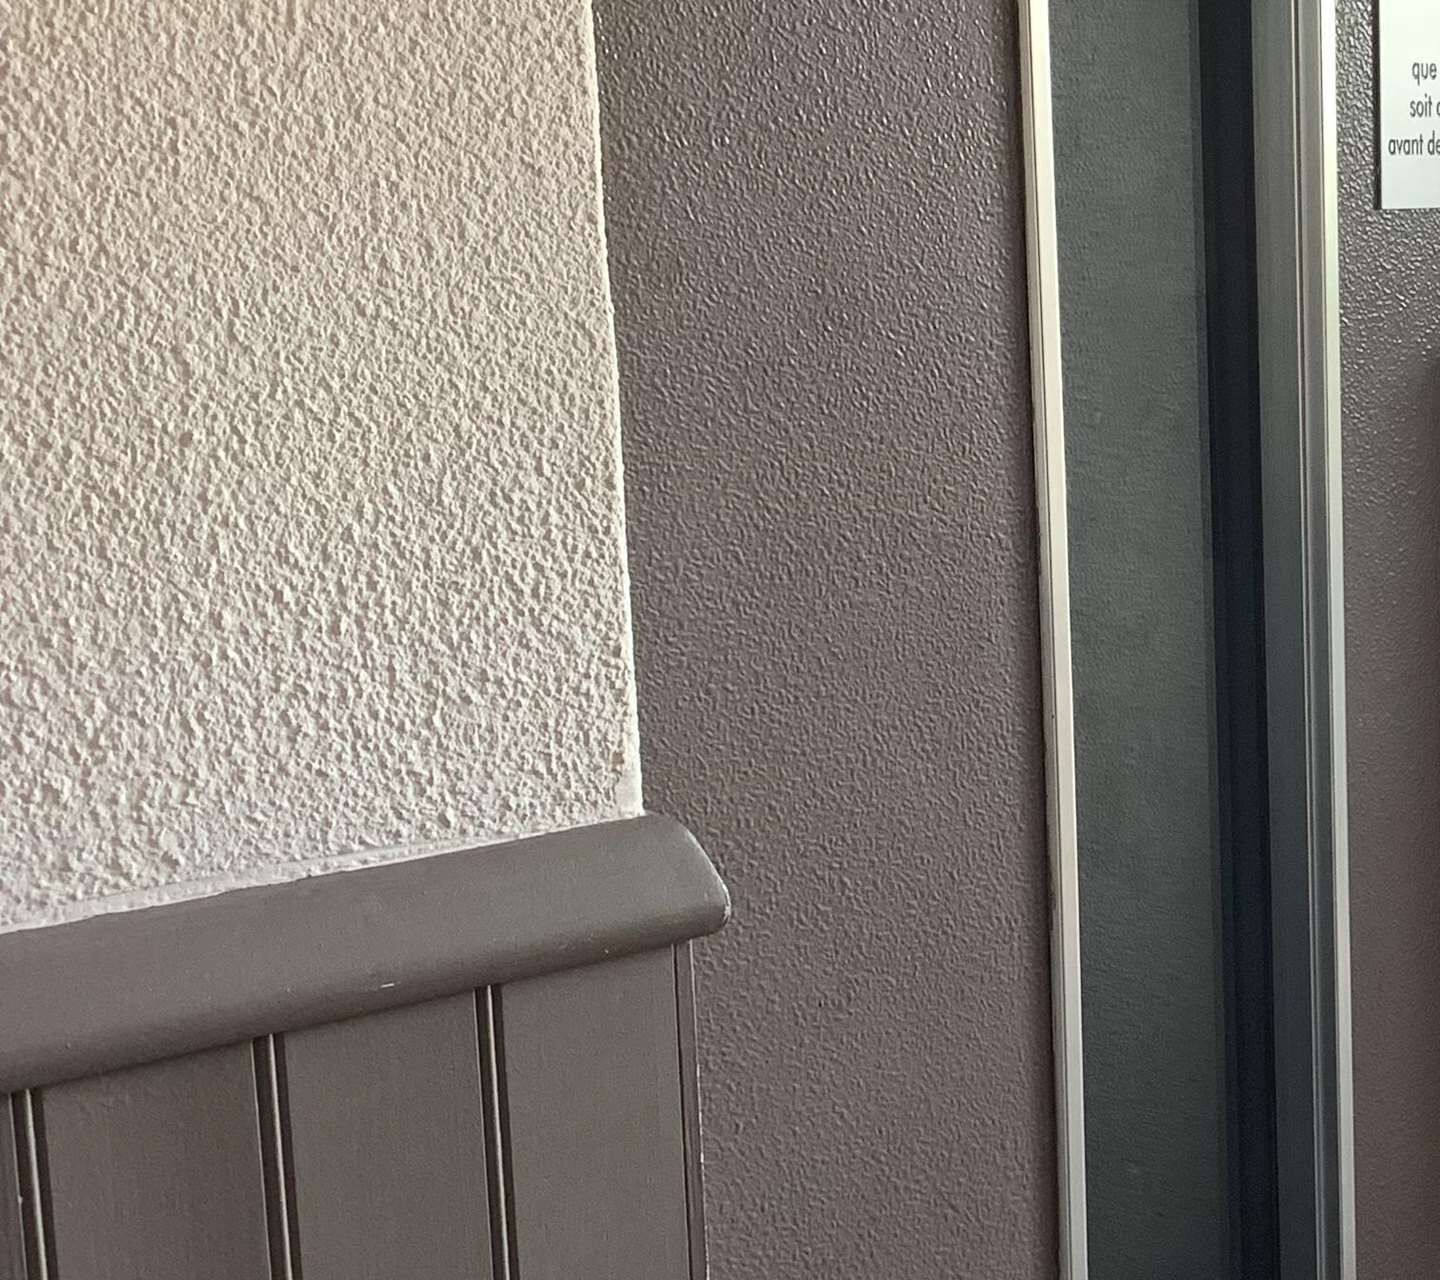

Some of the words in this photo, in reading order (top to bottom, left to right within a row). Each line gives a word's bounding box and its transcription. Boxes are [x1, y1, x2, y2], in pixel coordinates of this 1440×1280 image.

[1411, 62, 1437, 87] que
[1409, 93, 1433, 118] soit
[1387, 133, 1424, 156] avant
